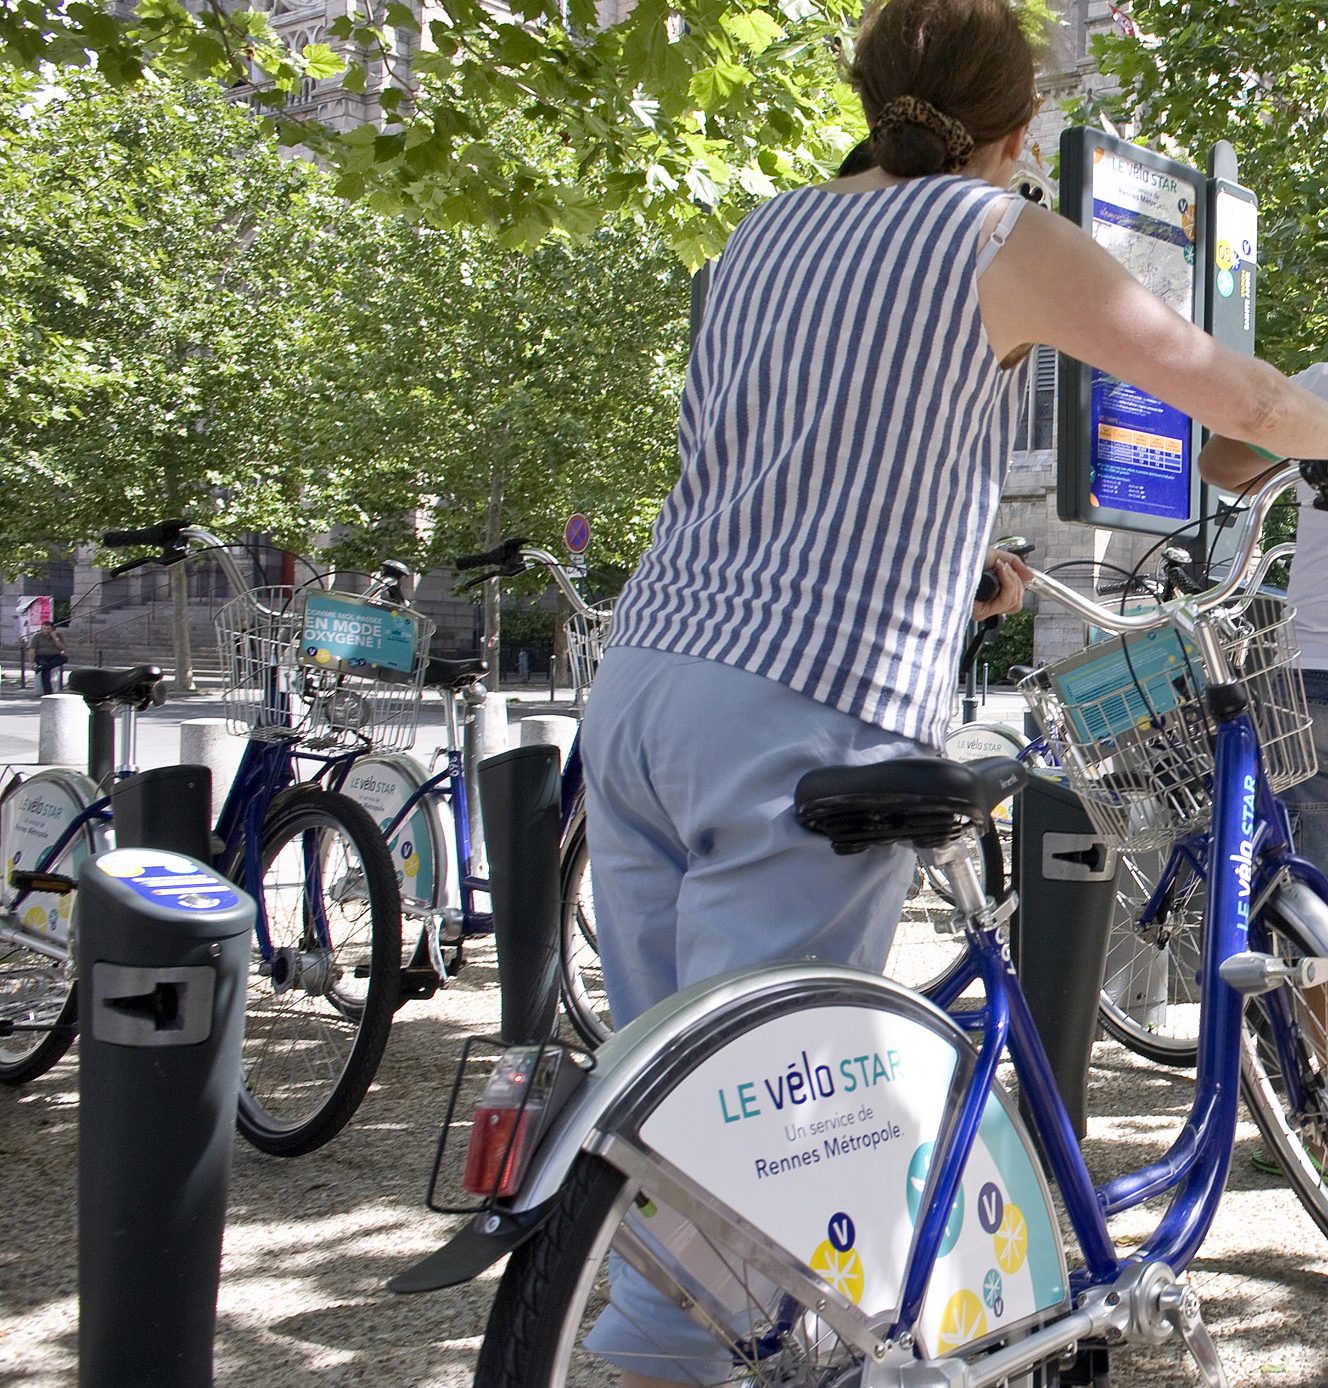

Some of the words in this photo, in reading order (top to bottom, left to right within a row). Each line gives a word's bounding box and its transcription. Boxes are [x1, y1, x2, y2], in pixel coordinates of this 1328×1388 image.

[1151, 173, 1177, 193] STAR
[306, 616, 328, 630] EN
[333, 619, 382, 637] MODE
[982, 743, 1002, 752] STAR
[351, 778, 360, 789] LE
[360, 775, 376, 791] vélo
[376, 781, 396, 795] STAR
[1230, 840, 1253, 897] vélo
[1242, 775, 1256, 836] STAR
[718, 1081, 762, 1124] LE
[764, 1050, 836, 1111] vélo
[840, 1050, 904, 1093] STAR
[785, 1124, 806, 1142] Un
[810, 1111, 855, 1136] service
[857, 1103, 874, 1122] de
[755, 1148, 821, 1180] Rennes
